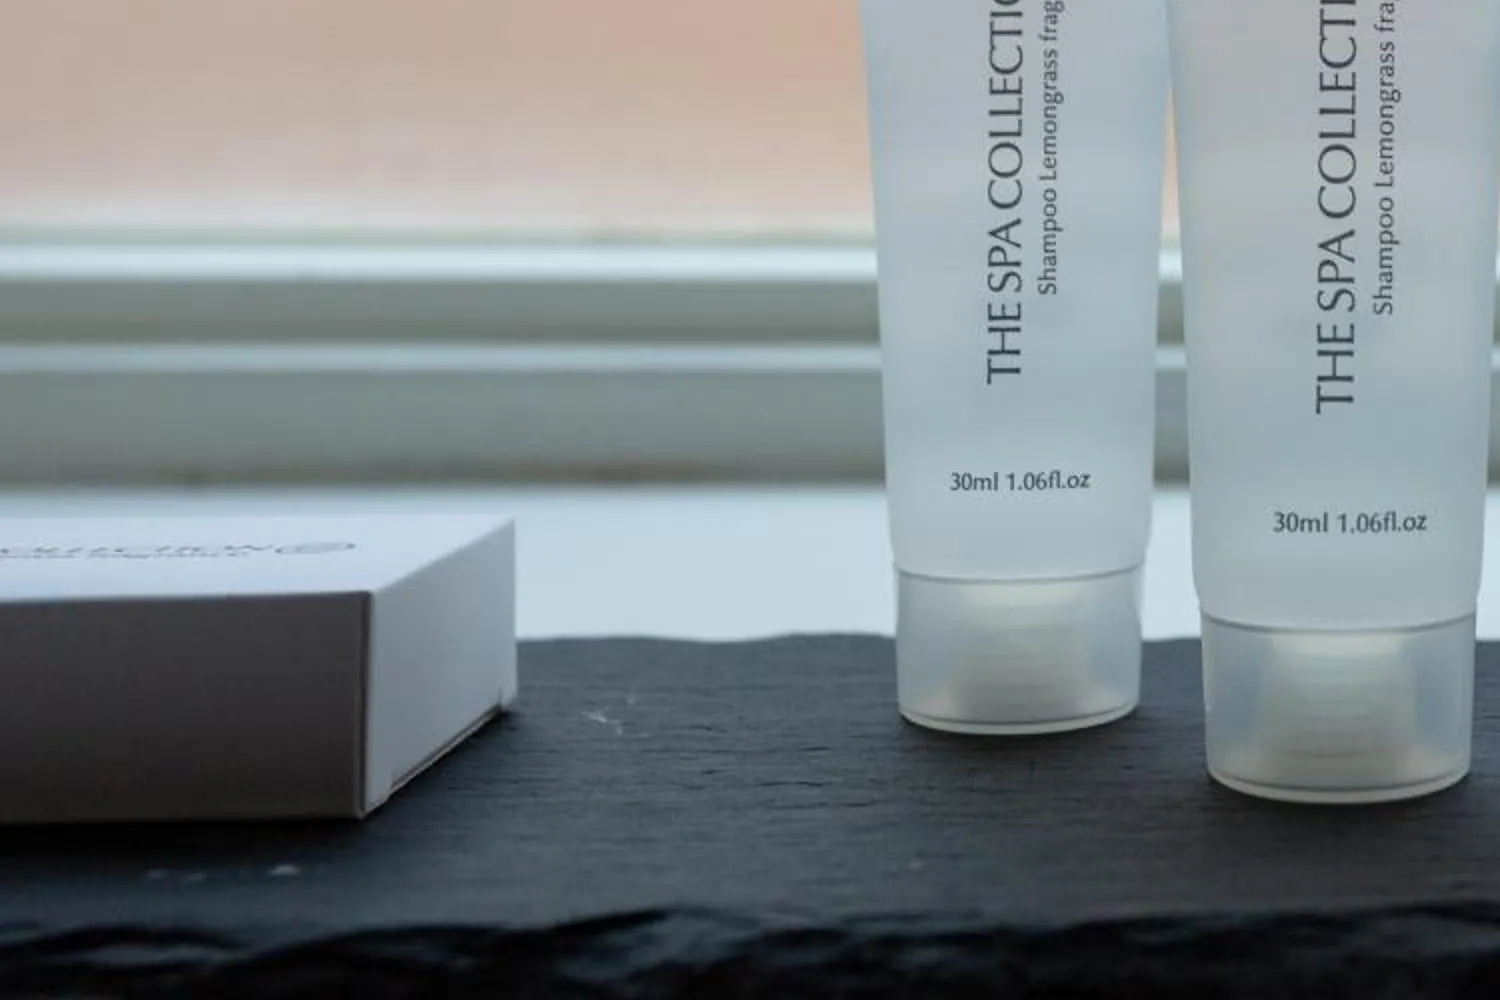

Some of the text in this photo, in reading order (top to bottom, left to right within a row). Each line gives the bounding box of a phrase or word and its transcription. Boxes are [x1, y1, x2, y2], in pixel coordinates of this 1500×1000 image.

[1038, 48, 1065, 181] Lemongrass
[1372, 41, 1402, 188] Lemongrass
[987, 217, 1023, 294] SPA
[1036, 187, 1064, 295] Shampoo
[1316, 228, 1357, 313] SPA
[1371, 196, 1401, 316] Shampoo
[986, 301, 1022, 386] THE
[1315, 323, 1355, 415] THE
[950, 469, 1091, 492] 30ml 1.06fl.oz
[1273, 511, 1427, 534] 30ml 1.06fl.oz
